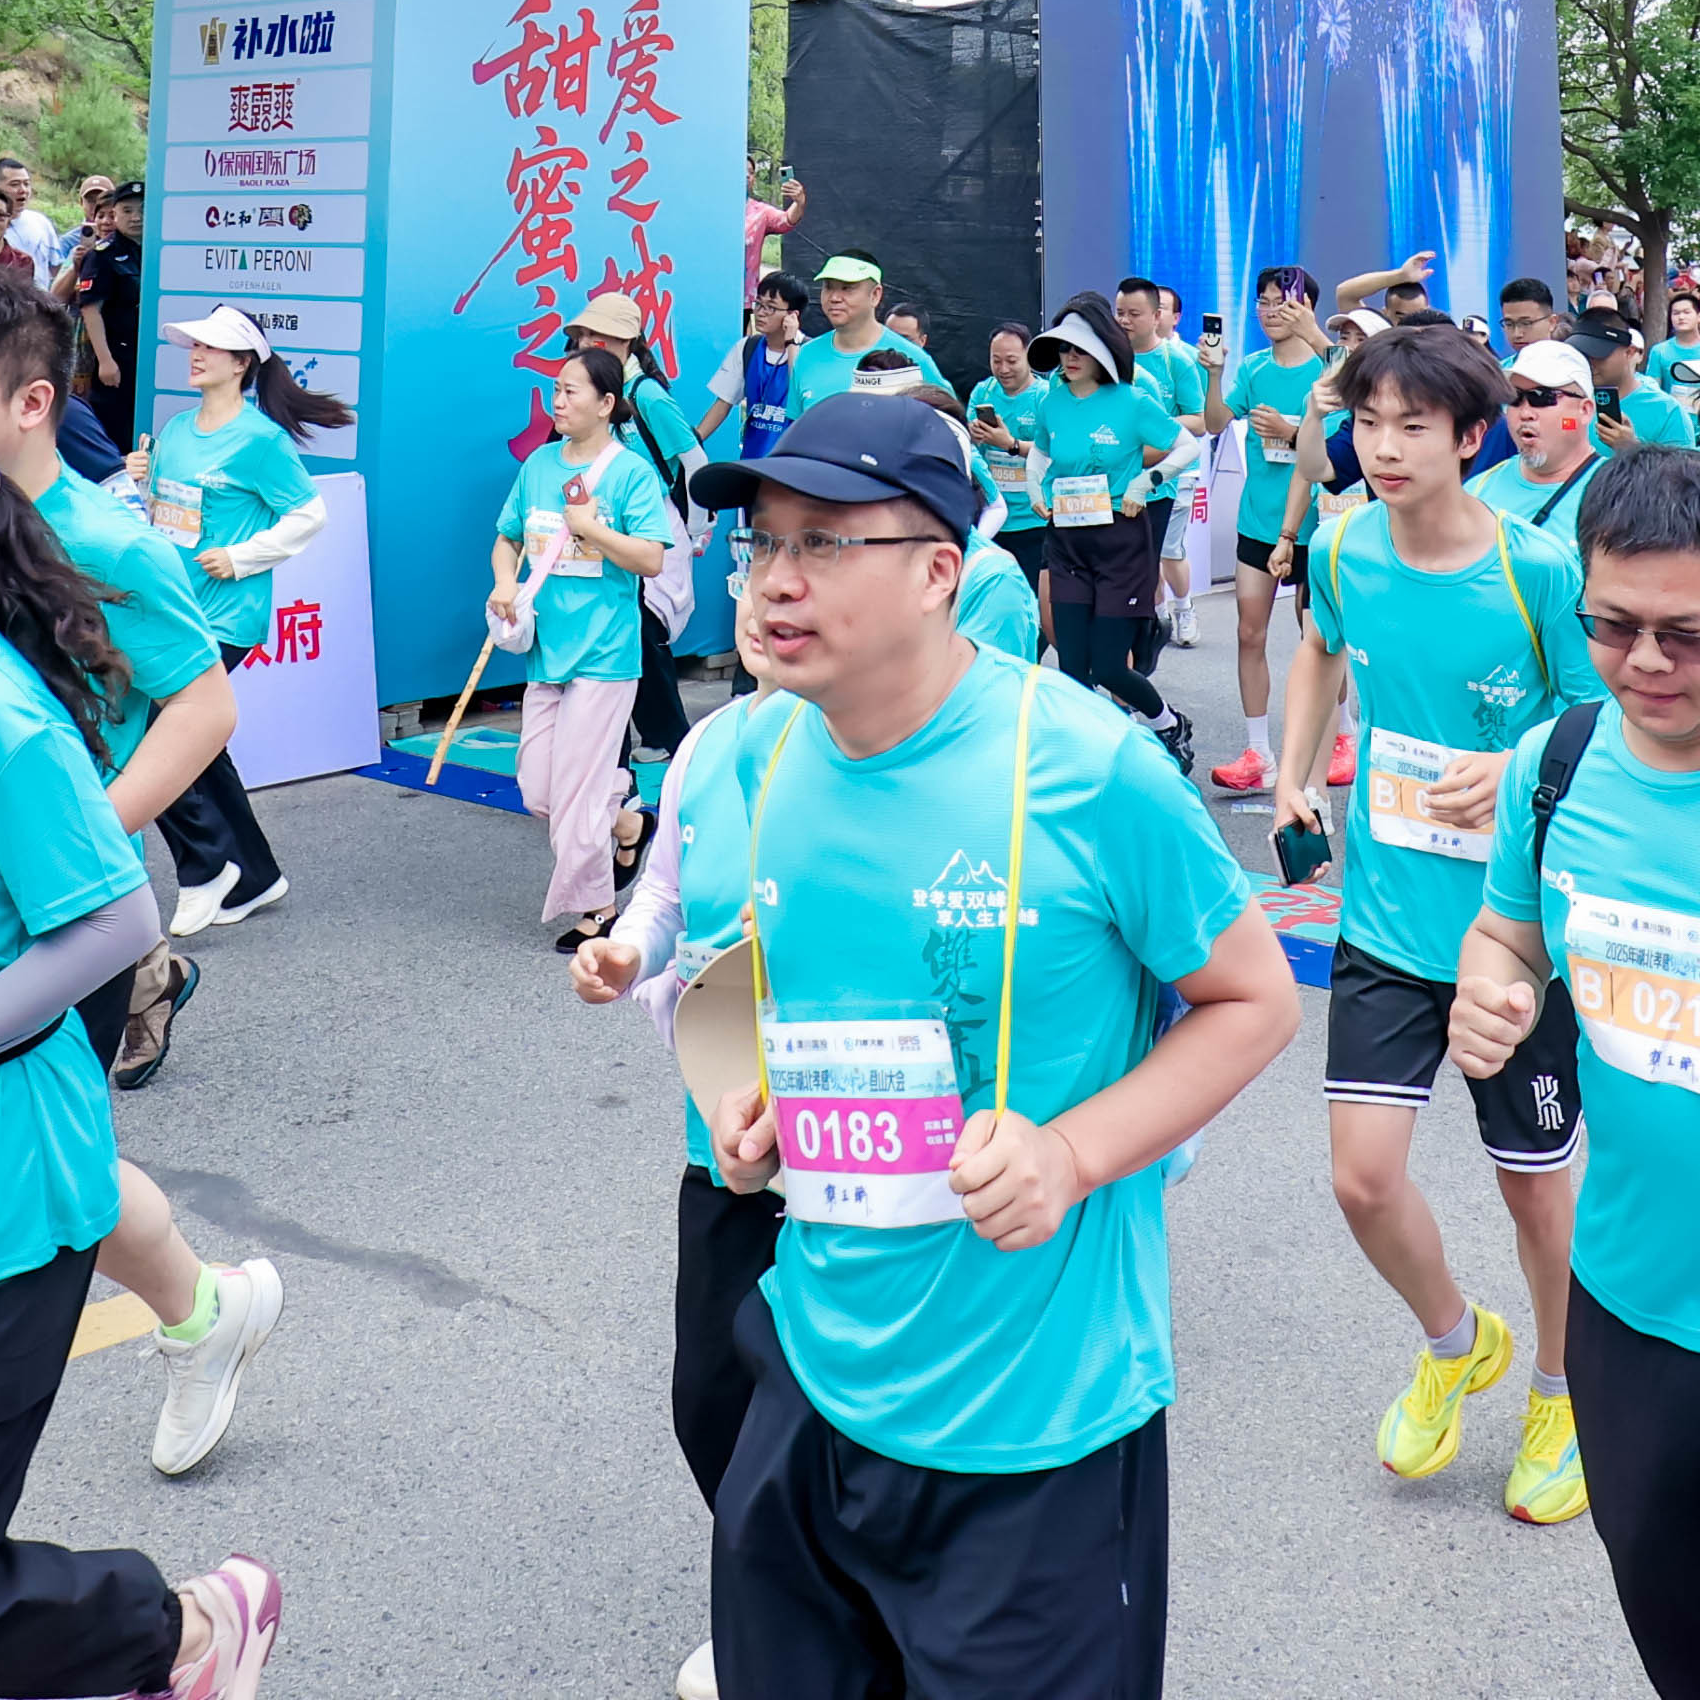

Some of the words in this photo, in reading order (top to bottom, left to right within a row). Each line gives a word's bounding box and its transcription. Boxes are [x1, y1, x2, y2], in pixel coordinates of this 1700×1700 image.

[232, 10, 336, 60] 补水啦
[227, 82, 295, 133] 爽露爽
[217, 149, 317, 177] 保丽国际广场
[239, 179, 263, 187] BAOLI
[265, 179, 290, 187] PLAZA
[205, 249, 248, 271] EVITA
[253, 249, 312, 272] PERONI
[1373, 777, 1397, 810] B
[1575, 964, 1604, 1010] B
[795, 1109, 904, 1163] 0183
